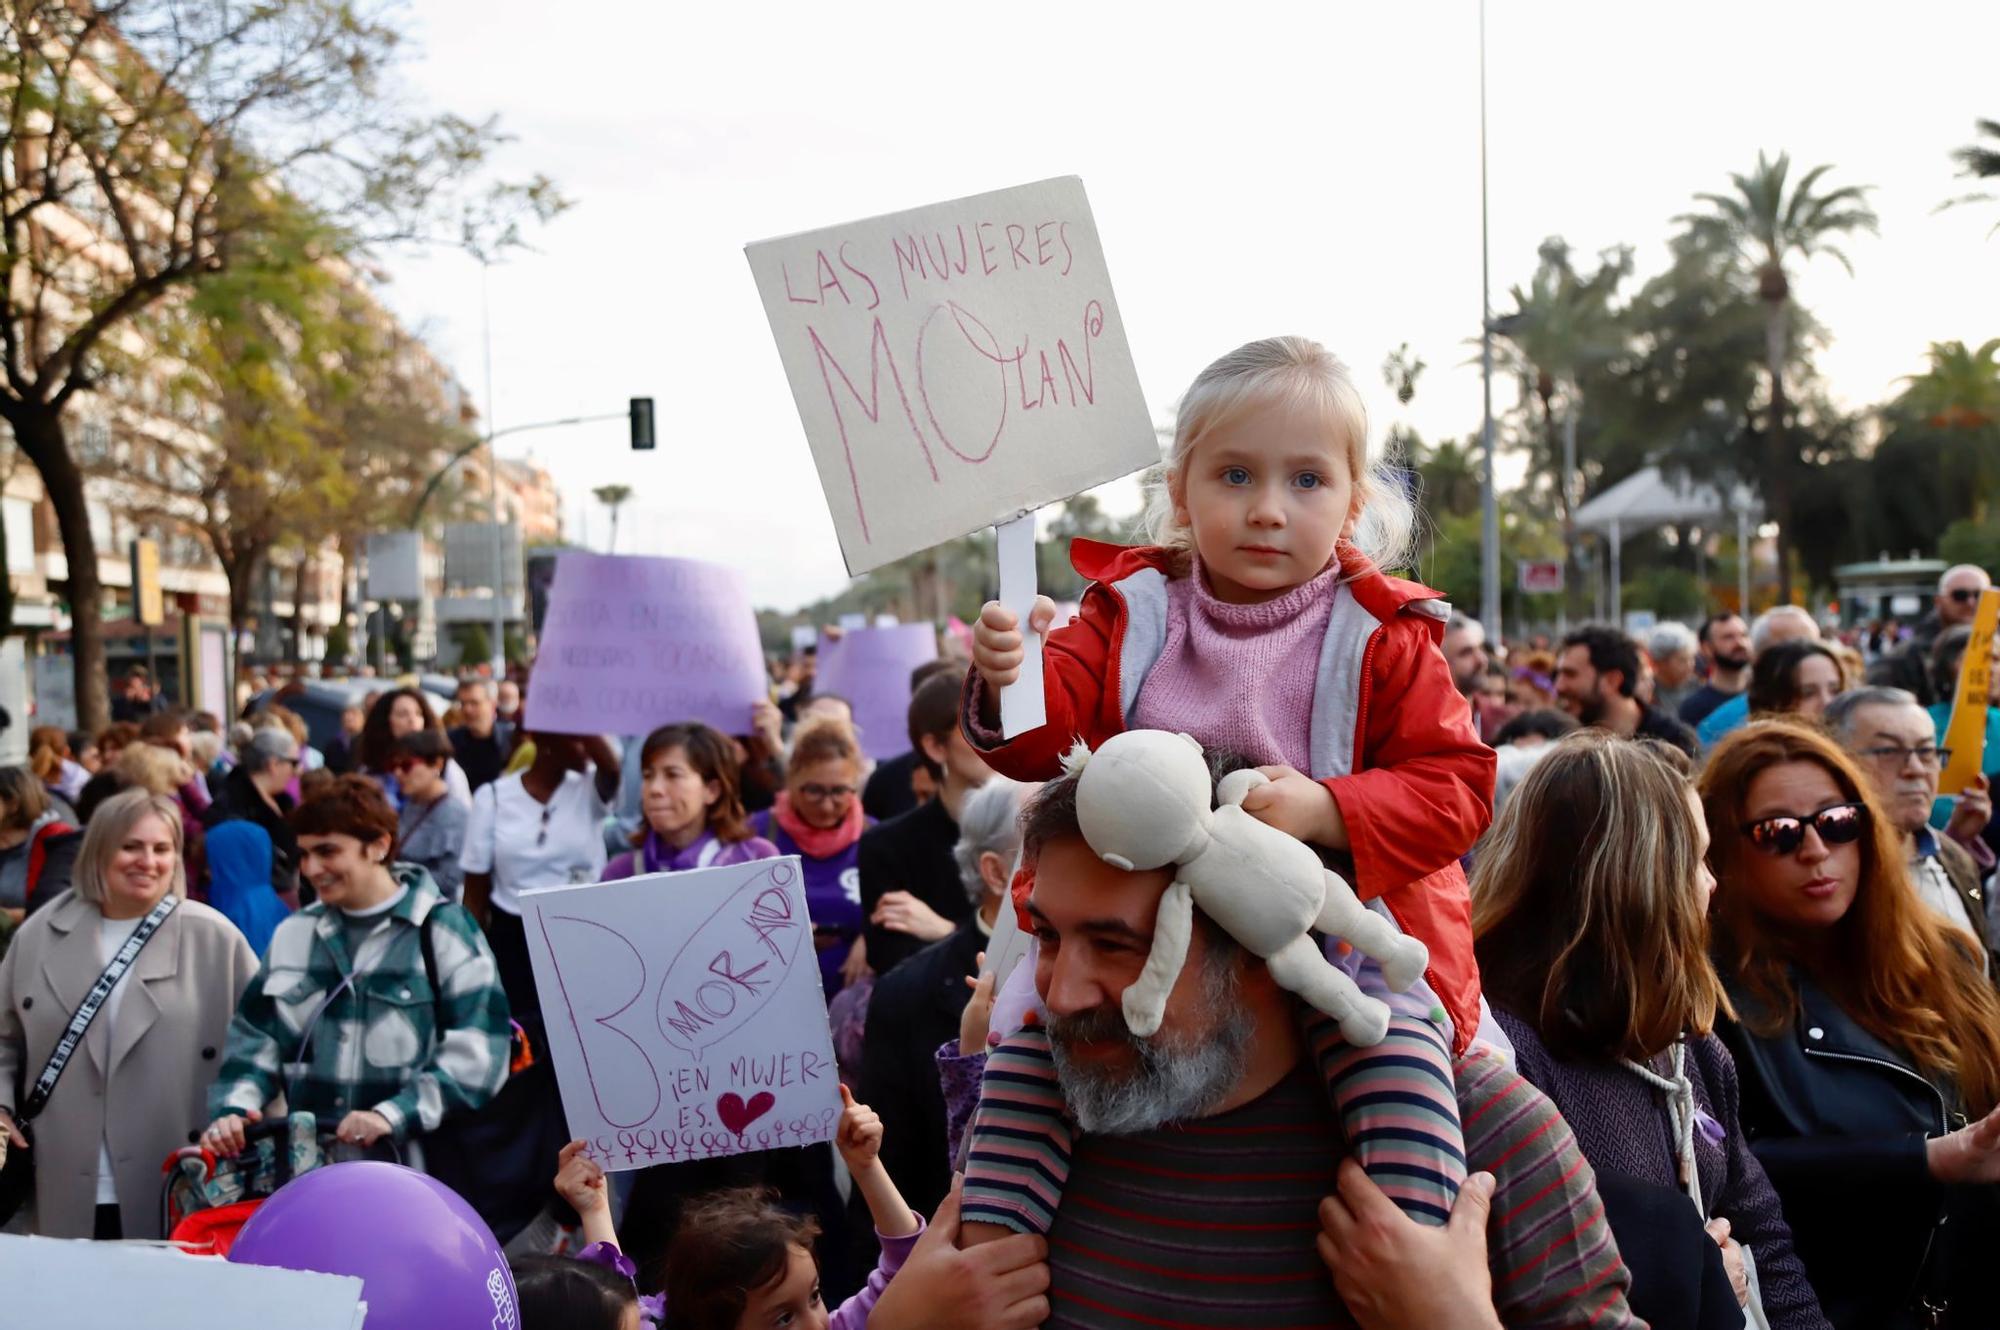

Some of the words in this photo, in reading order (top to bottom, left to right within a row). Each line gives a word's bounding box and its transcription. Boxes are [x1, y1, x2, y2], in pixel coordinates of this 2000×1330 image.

[782, 240, 880, 311] LAS
[892, 221, 1073, 301] MUJERES
[806, 299, 1104, 545] MOLAN
[666, 863, 798, 1042] MORADO
